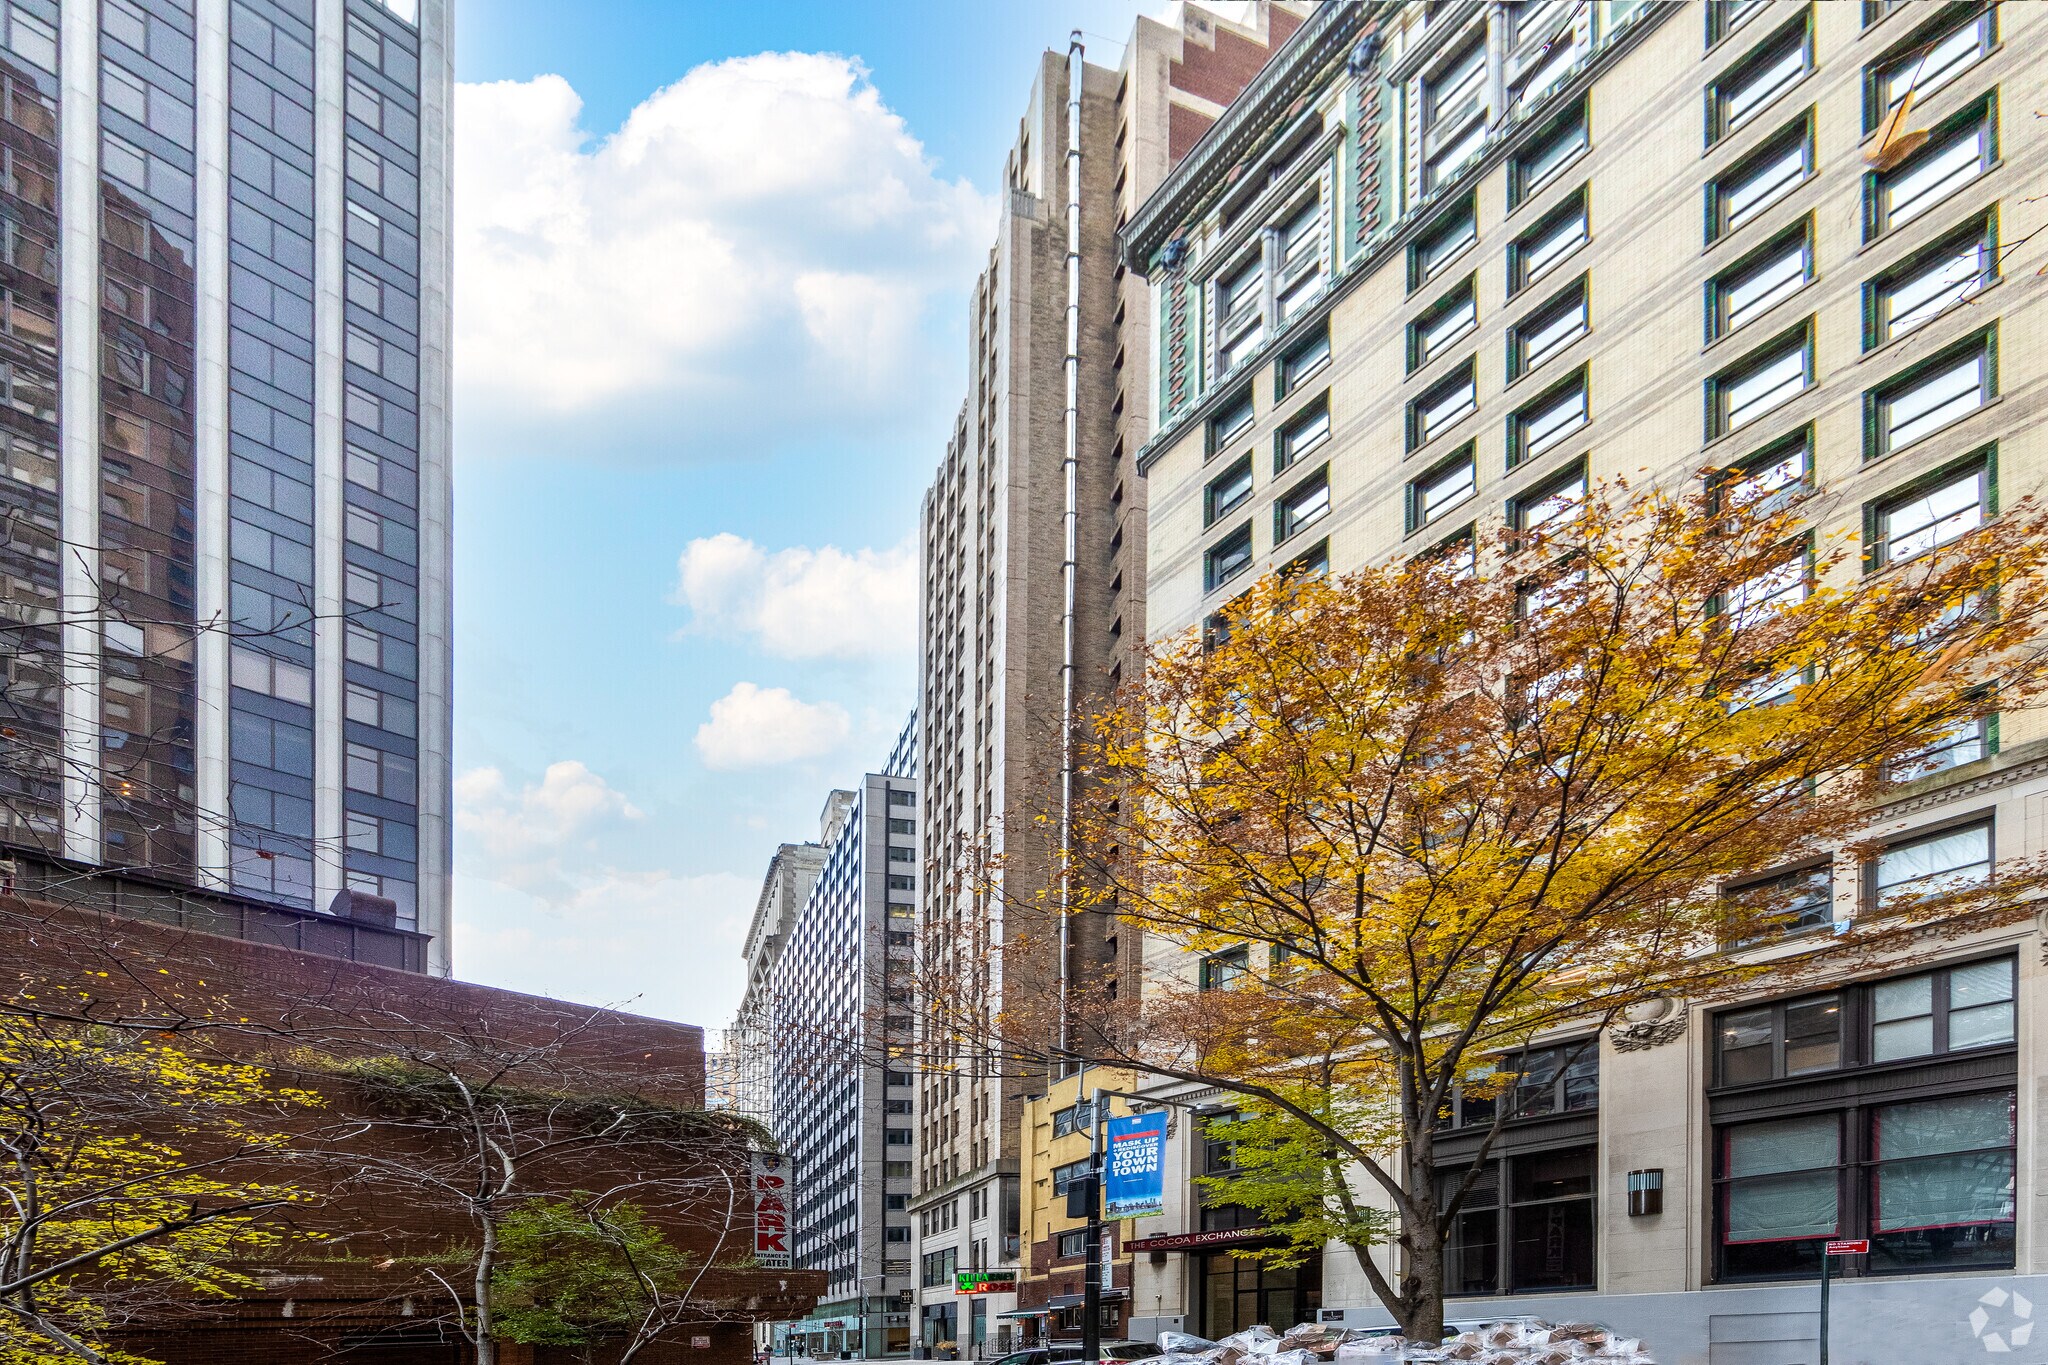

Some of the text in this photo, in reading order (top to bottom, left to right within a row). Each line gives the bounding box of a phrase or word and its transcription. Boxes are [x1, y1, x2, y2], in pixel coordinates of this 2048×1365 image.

[1113, 1136, 1159, 1149] MASK UP
[1113, 1146, 1159, 1161] YOUR
[1112, 1155, 1158, 1169] DOWN
[1112, 1163, 1158, 1177] TOWN
[756, 1174, 789, 1252] PARK
[1129, 1241, 1146, 1250] THE
[1149, 1236, 1191, 1248] COCOA
[977, 1282, 1016, 1293] ROSE
